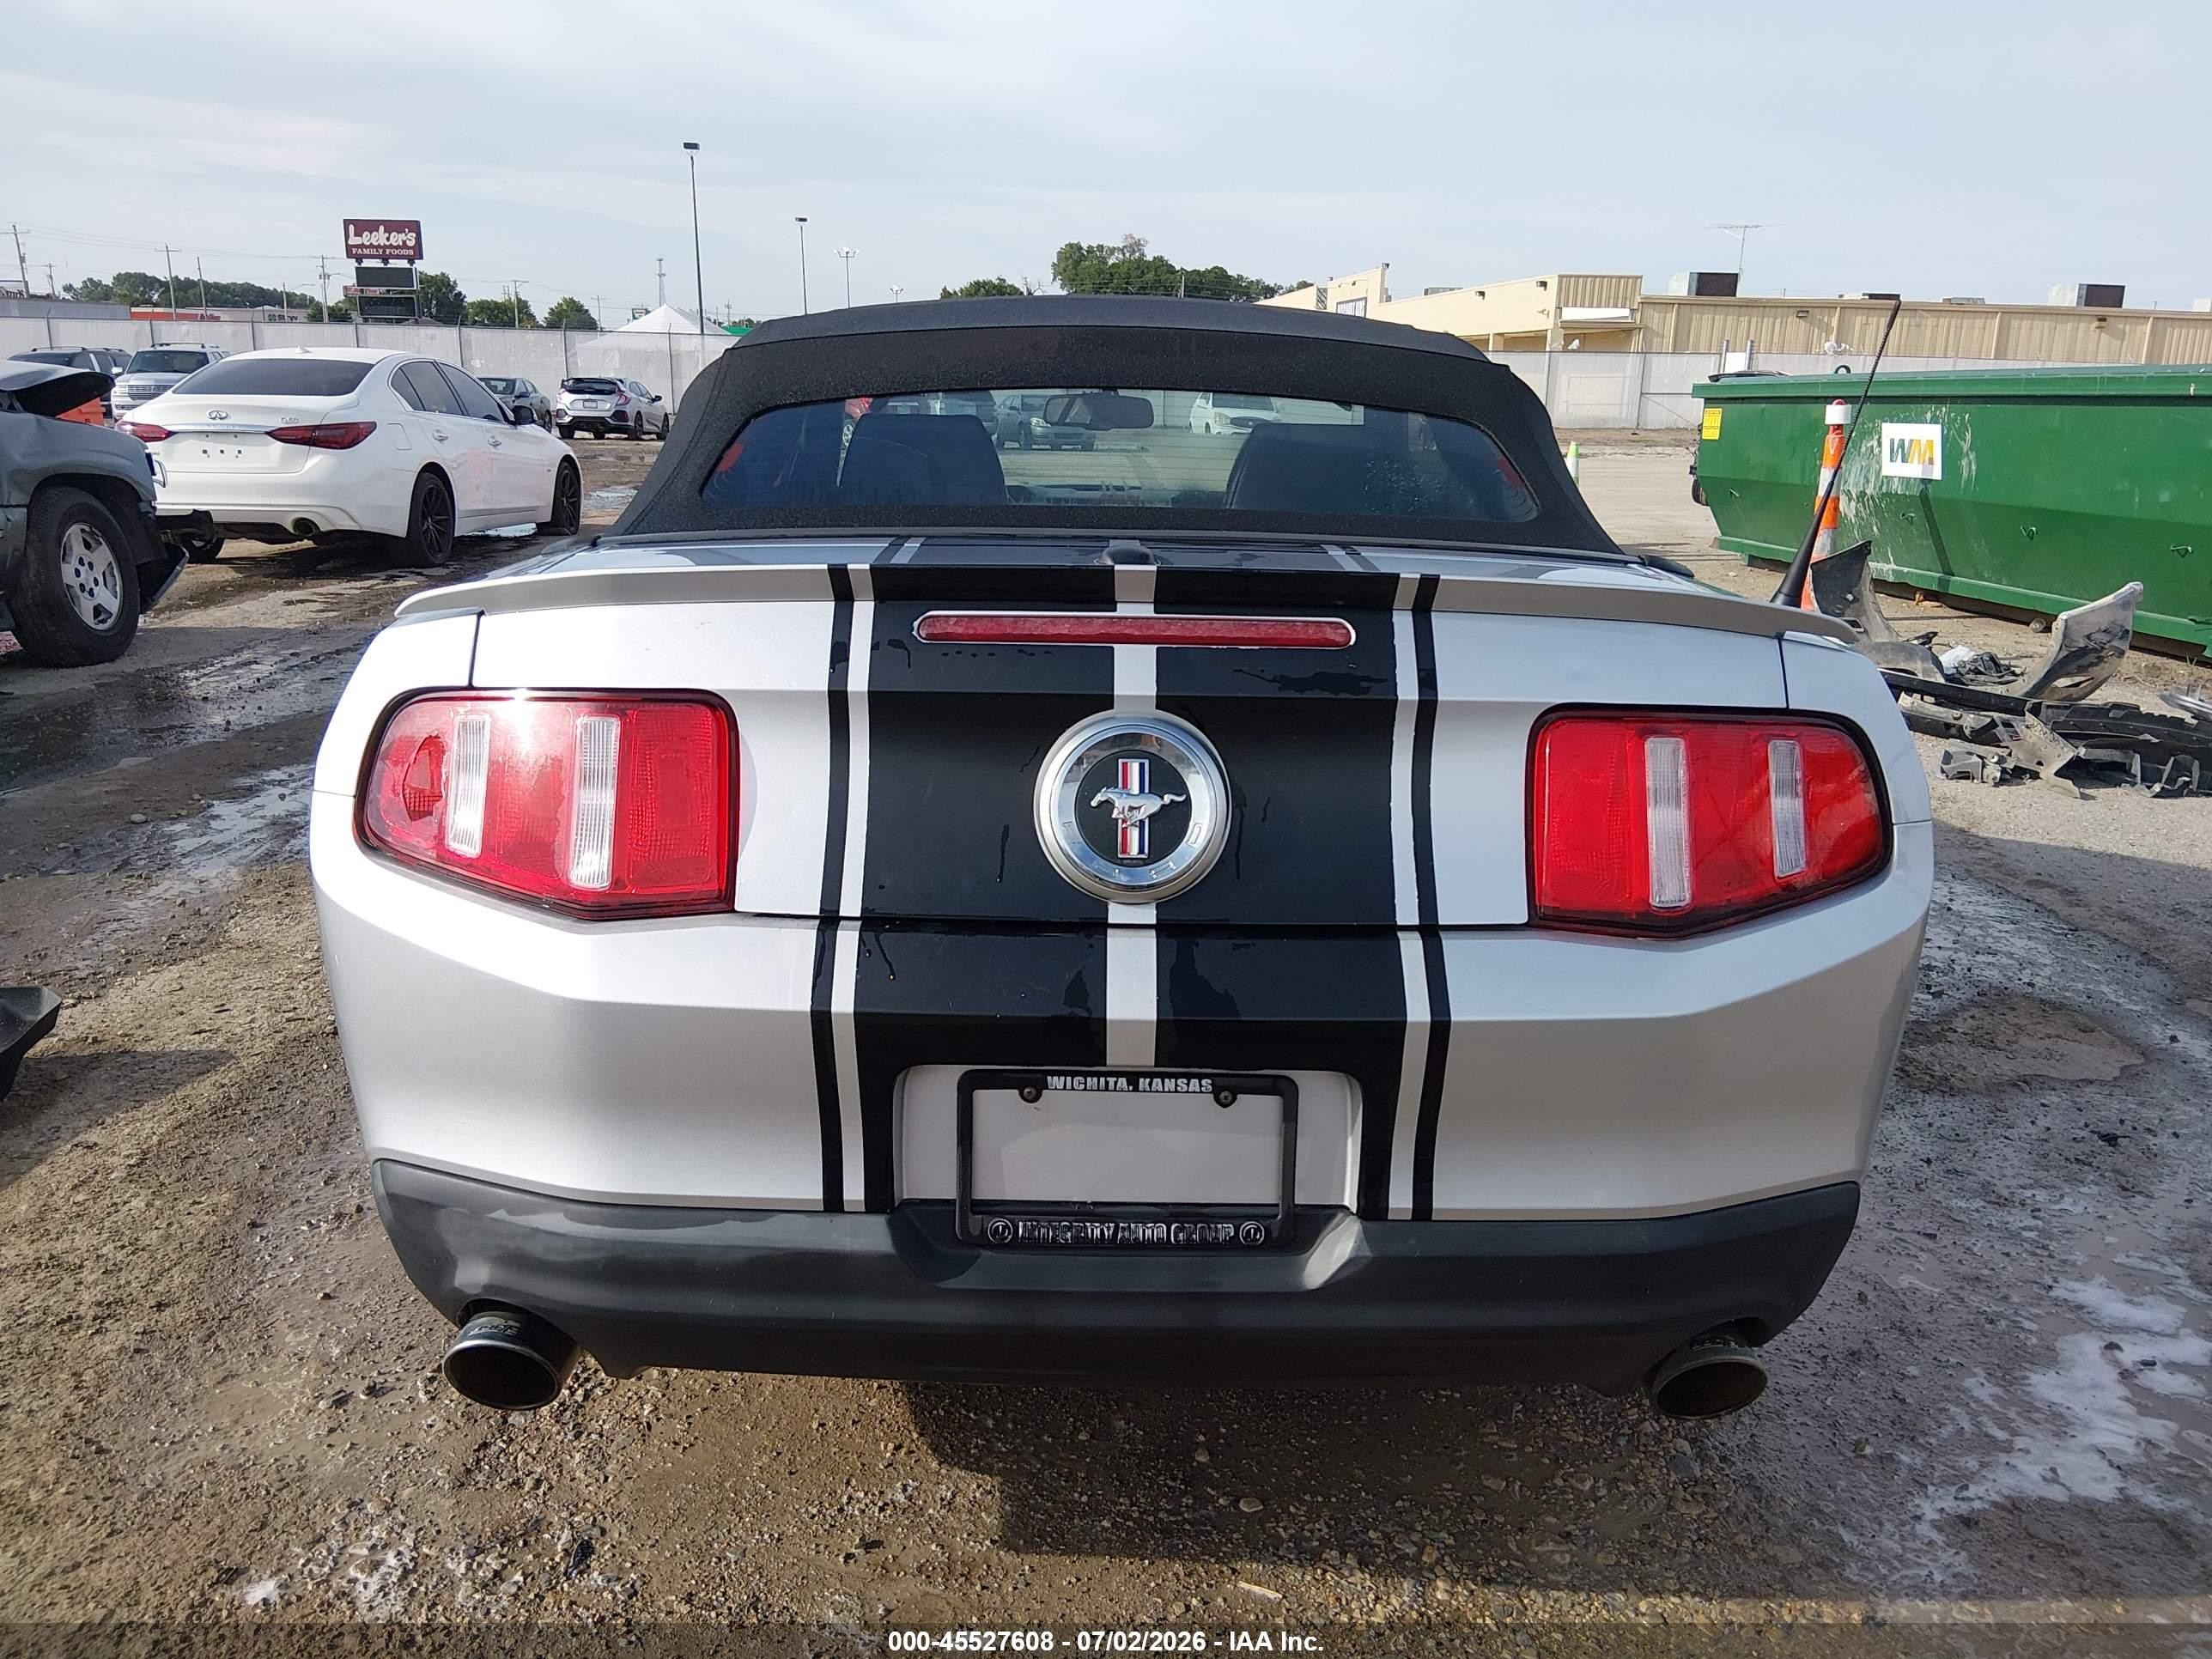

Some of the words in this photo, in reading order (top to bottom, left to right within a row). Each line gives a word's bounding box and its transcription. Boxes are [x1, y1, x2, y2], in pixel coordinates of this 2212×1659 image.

[348, 224, 416, 246] Leeker's
[1889, 439, 1934, 465] WM
[1047, 1075, 1133, 1091] WICHITA,
[1139, 1078, 1212, 1092] KANSAS
[1019, 1220, 1115, 1243] INTEGRITY
[1117, 1222, 1167, 1244] AUTO
[1170, 1223, 1234, 1244] GROUP
